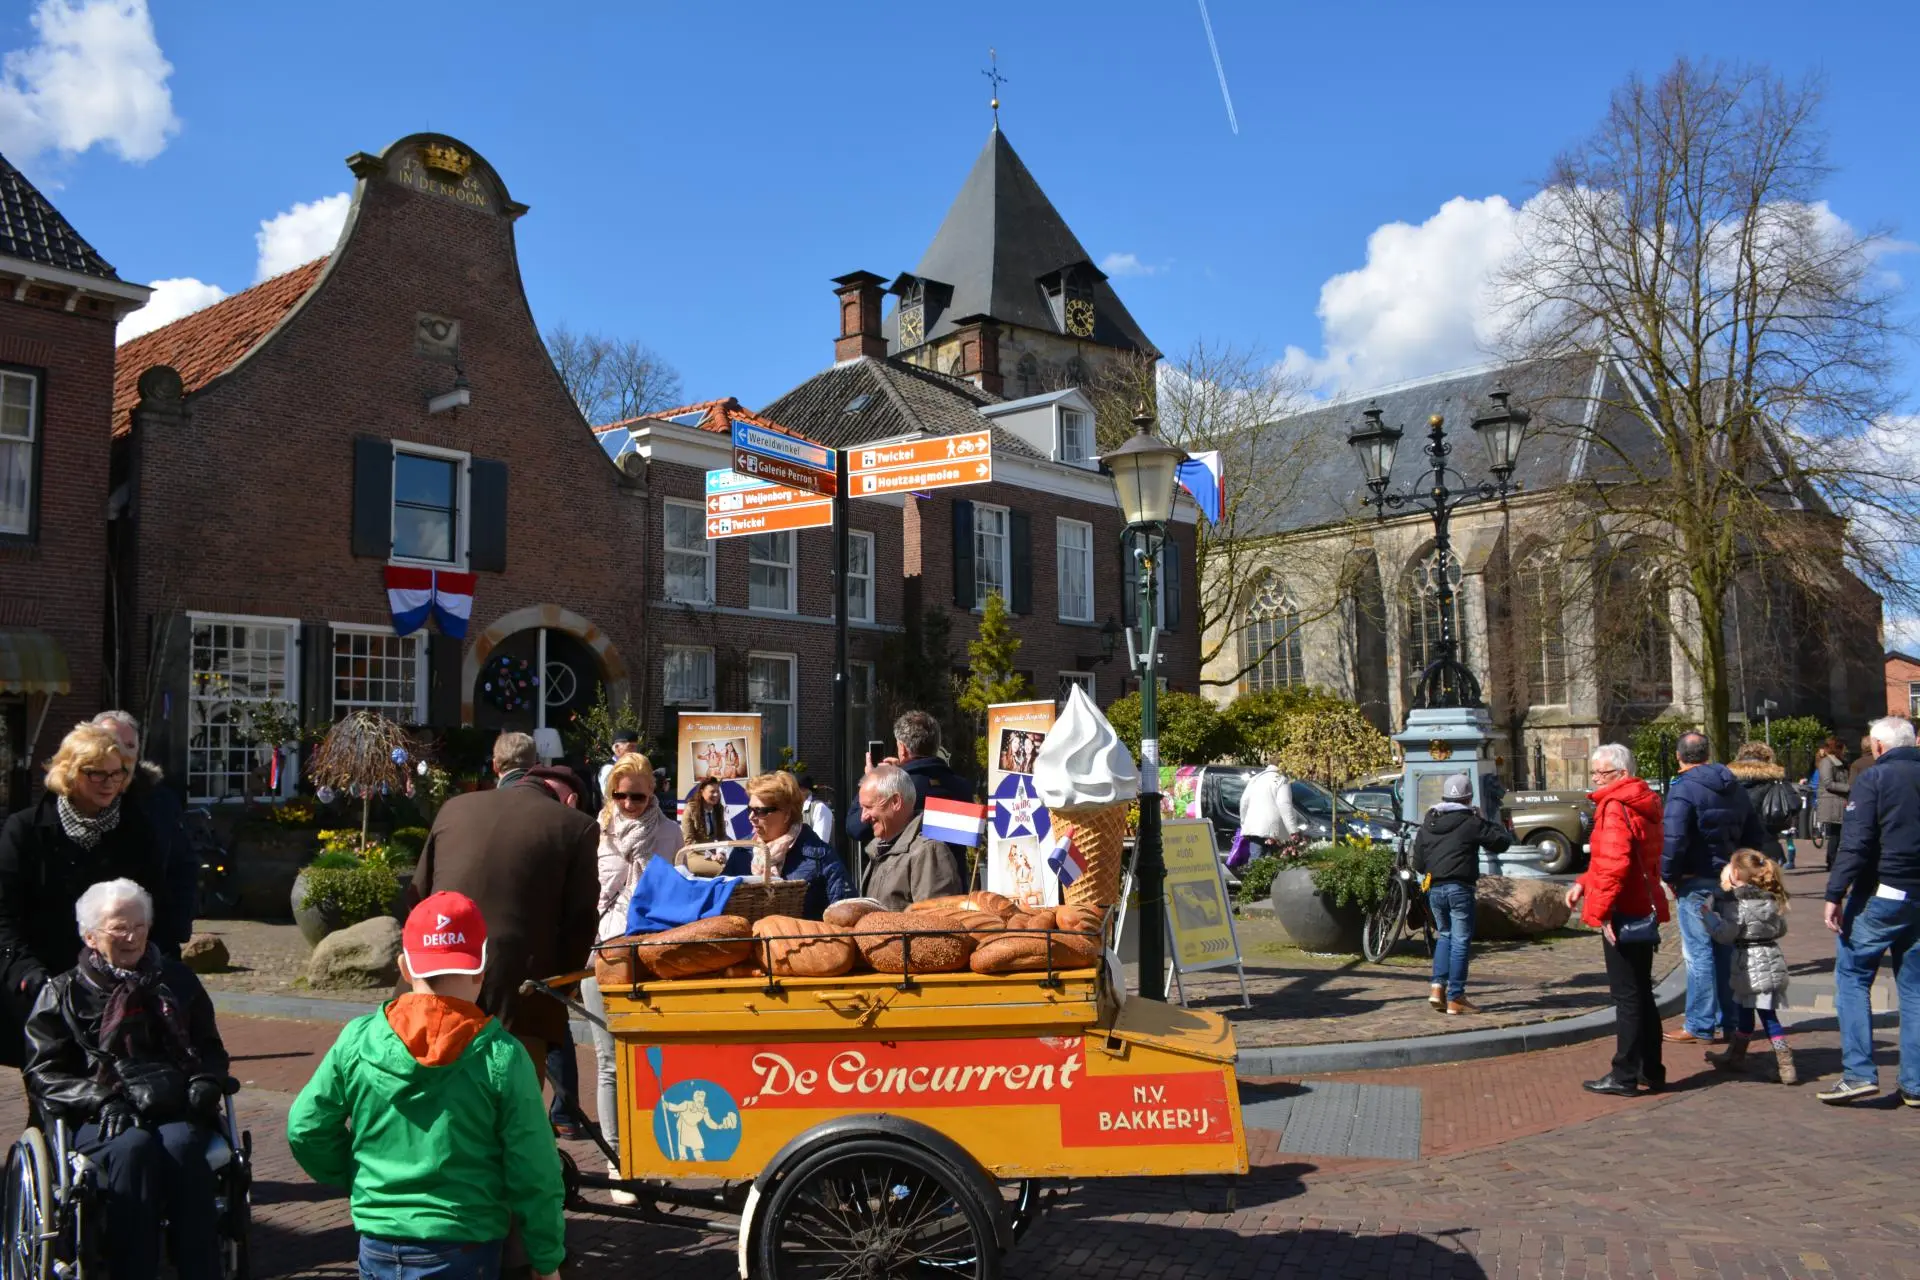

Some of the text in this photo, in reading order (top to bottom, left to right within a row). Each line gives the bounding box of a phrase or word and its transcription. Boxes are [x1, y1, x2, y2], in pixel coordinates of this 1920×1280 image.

[399, 169, 485, 208] IN DE KROON
[462, 177, 480, 191] 64
[748, 432, 801, 456] Wereldwinkel
[876, 448, 915, 463] Twickel
[758, 461, 786, 478] Galerie
[788, 469, 813, 485] Perron
[813, 475, 819, 485] 1
[877, 469, 960, 488] Houtzaagmolen
[744, 490, 793, 505] Weijenborg
[732, 516, 765, 530] Twickel
[423, 932, 466, 947] DEKRA
[1132, 1085, 1168, 1104] N.V.
[1098, 1107, 1209, 1135] BAKKERIJ
